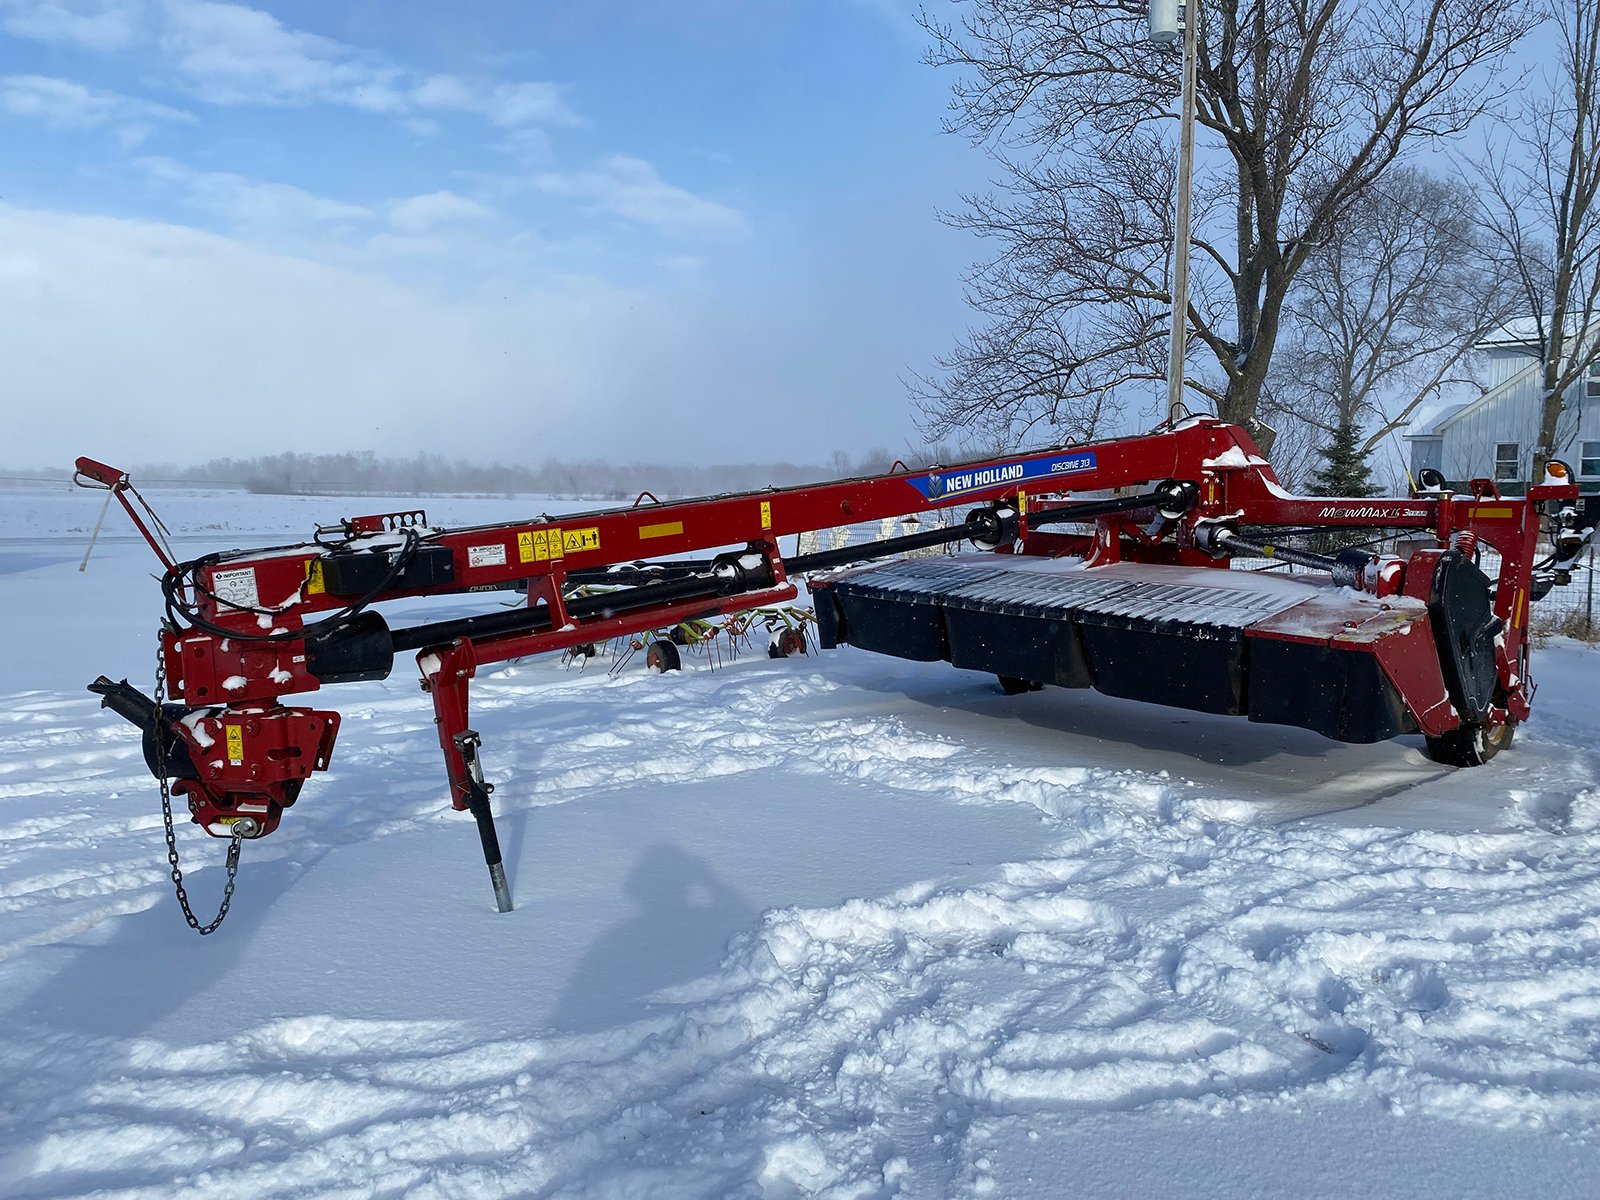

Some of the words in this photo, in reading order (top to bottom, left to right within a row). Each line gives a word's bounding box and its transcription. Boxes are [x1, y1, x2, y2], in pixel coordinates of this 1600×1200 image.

[1051, 459, 1079, 472] DISCBINE
[1080, 458, 1091, 468] 313
[946, 474, 972, 492] NEW
[974, 464, 1024, 486] HOLLAND
[223, 570, 252, 579] IMPORTANT
